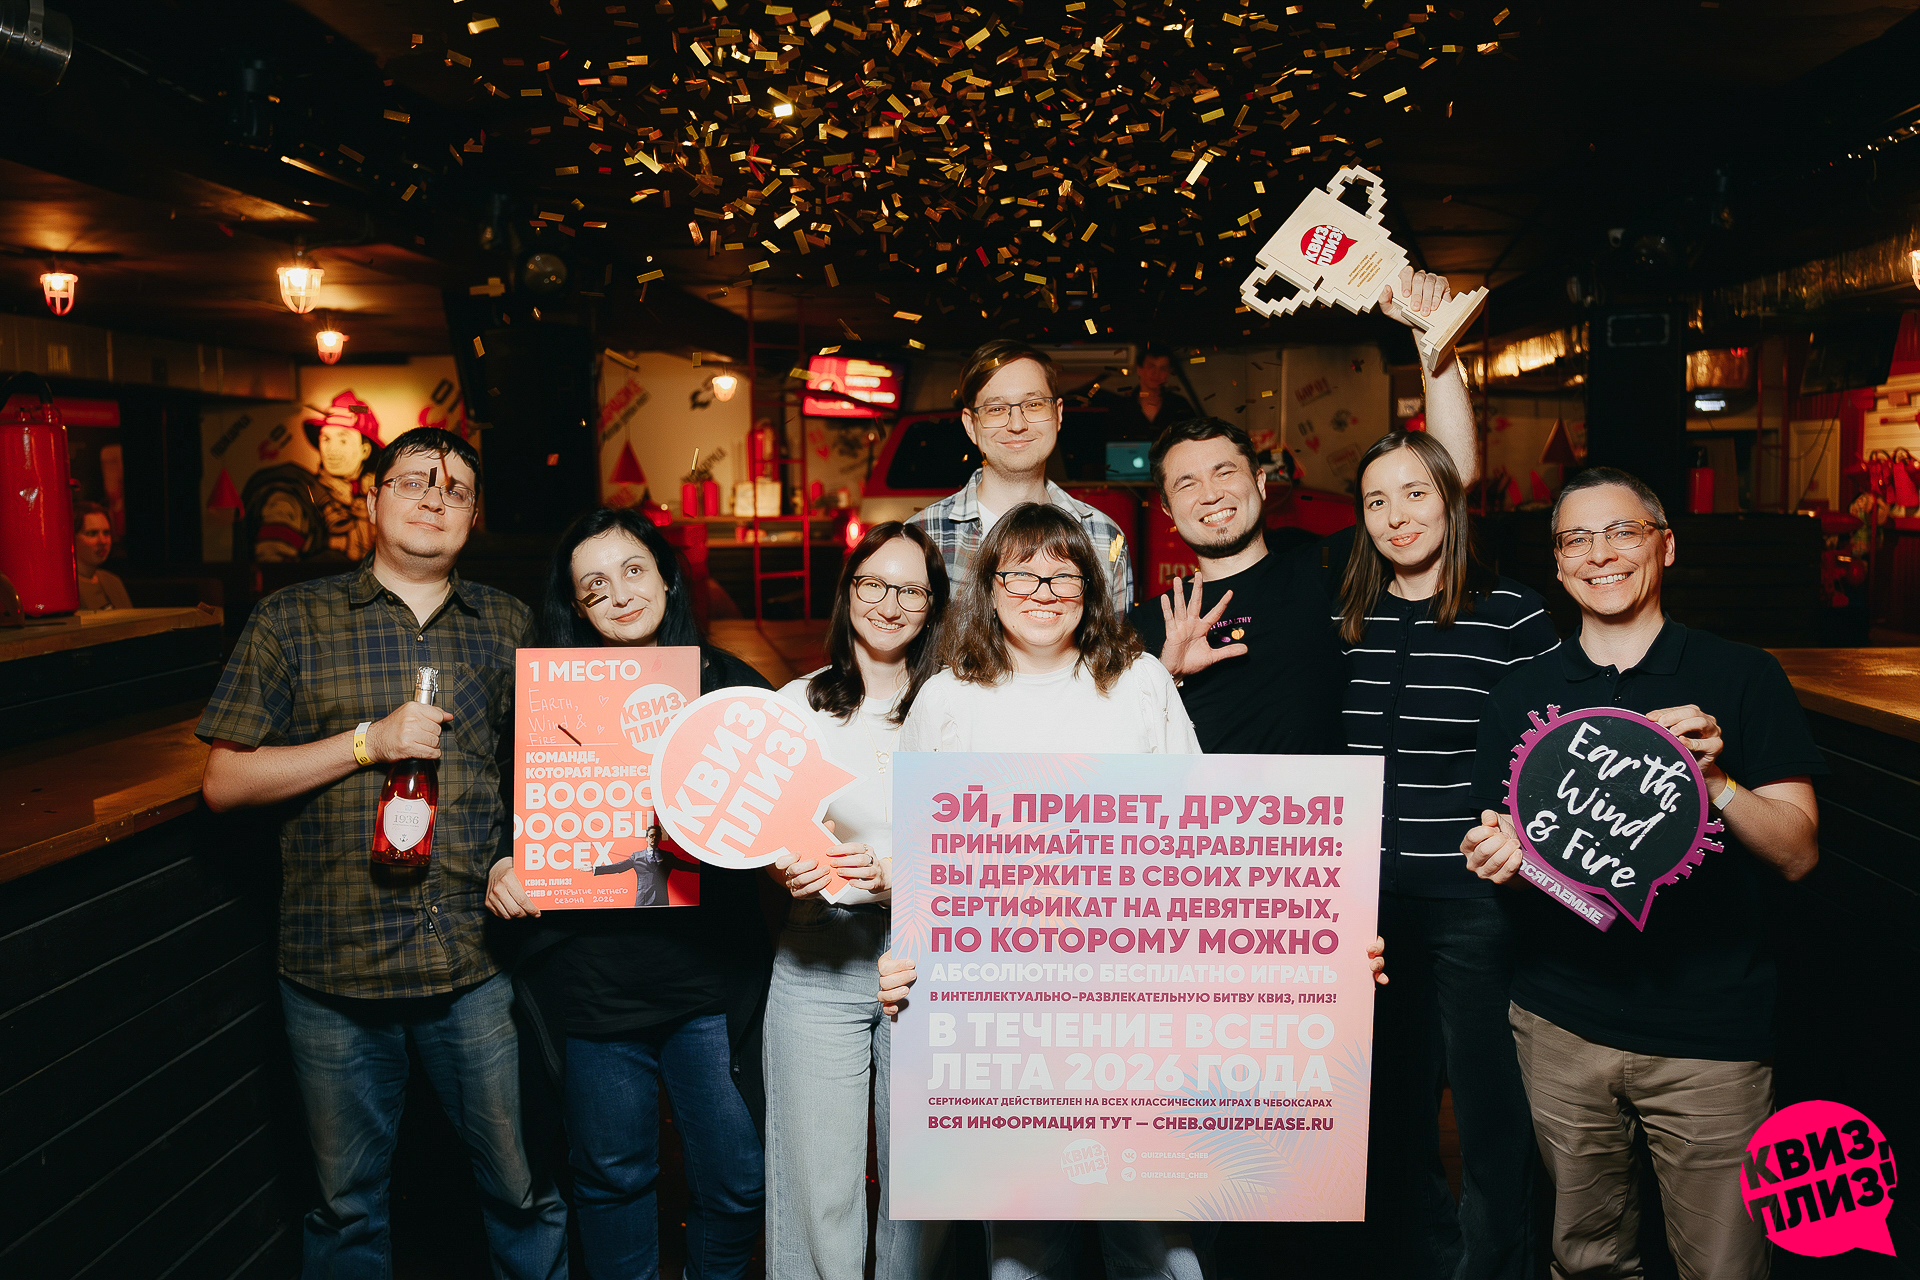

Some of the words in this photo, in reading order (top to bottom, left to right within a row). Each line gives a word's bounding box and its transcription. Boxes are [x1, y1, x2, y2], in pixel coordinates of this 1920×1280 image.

[1317, 226, 1345, 266] ПЛИЗ!
[529, 661, 539, 682] 1
[548, 660, 641, 681] МЕСТО
[624, 714, 678, 744] ПЛИ
[525, 751, 600, 764] КОМАНДЕ,
[667, 700, 780, 836] КВИЗ,
[1568, 722, 1691, 813] Earth,
[525, 767, 591, 779] КОТОРАЯ
[705, 711, 816, 859] ПЛИЗ!
[394, 815, 419, 824] 1936
[932, 785, 1001, 828] ЭЙ,
[1013, 794, 1169, 829] ПРИВЕТ,
[1179, 795, 1344, 829] ДРУЗЬЯ!
[1557, 769, 1665, 850] Wind
[524, 842, 615, 871] ВСЕХ
[931, 829, 1114, 854] ПРИНИМАЙТЕ
[1121, 835, 1343, 858] ПОЗДРАВЛЕНИЯ:
[1526, 810, 1560, 842] &
[1562, 828, 1636, 888] Fire
[525, 878, 547, 887] КВИЗ,
[549, 878, 572, 886] ПЛИЗ!
[931, 864, 972, 885] ВЫ
[980, 865, 1112, 888] ДЕРЖИТЕ
[1119, 866, 1136, 885] В
[1142, 866, 1241, 887] СВОИХ
[1249, 867, 1341, 887] РУКАХ
[931, 896, 1117, 917] СЕРТИФИКАТ
[1124, 897, 1161, 917] НА
[1167, 898, 1339, 922] ДЕВЯТЕРЫХ,
[932, 927, 982, 952] ПО
[991, 927, 1190, 953] КОТОРОМУ
[1199, 928, 1339, 954] МОЖНО
[930, 963, 1094, 982] АБСОЛЮТНО
[1100, 964, 1245, 983] БЕСПЛАТНО
[1251, 965, 1338, 983] ИГРАТЬ
[930, 992, 938, 1001] В
[1213, 992, 1254, 1003] БИТВУ
[1258, 993, 1295, 1005] КВИЗ,
[1298, 993, 1337, 1003] ПЛИЗ!
[929, 1012, 957, 1046] В
[967, 1012, 1173, 1048] ТЕЧЕНИЕ
[1185, 1013, 1335, 1049] ВСЕГО
[928, 1053, 1054, 1090] ЛЕТА
[1064, 1052, 1185, 1092] 2026
[1197, 1054, 1333, 1098] ГОДА
[928, 1097, 999, 1106] СЕРТИФИКАТ
[1001, 1096, 1082, 1107] ДЕЙСТВИТЕЛЕН
[1085, 1097, 1099, 1106] НА
[1101, 1097, 1128, 1106] ВСЕХ
[1131, 1098, 1216, 1107] КЛАССИЧЕСКИХ
[1219, 1098, 1250, 1107] ИГРАХ
[1254, 1099, 1261, 1107] В
[1263, 1099, 1332, 1107] ЧЕБОКСАРАХ
[928, 1116, 963, 1129] ВСЯ
[967, 1115, 1096, 1131] ИНФОРМАЦИЯ
[1100, 1117, 1132, 1129] ТУТ
[1153, 1117, 1334, 1131] CHEB.QUIZPLEASE.RU
[1141, 1152, 1209, 1160] QUIZPLEASE_CHEB
[1141, 1172, 1209, 1180] QUIZPLEASE_CHEB
